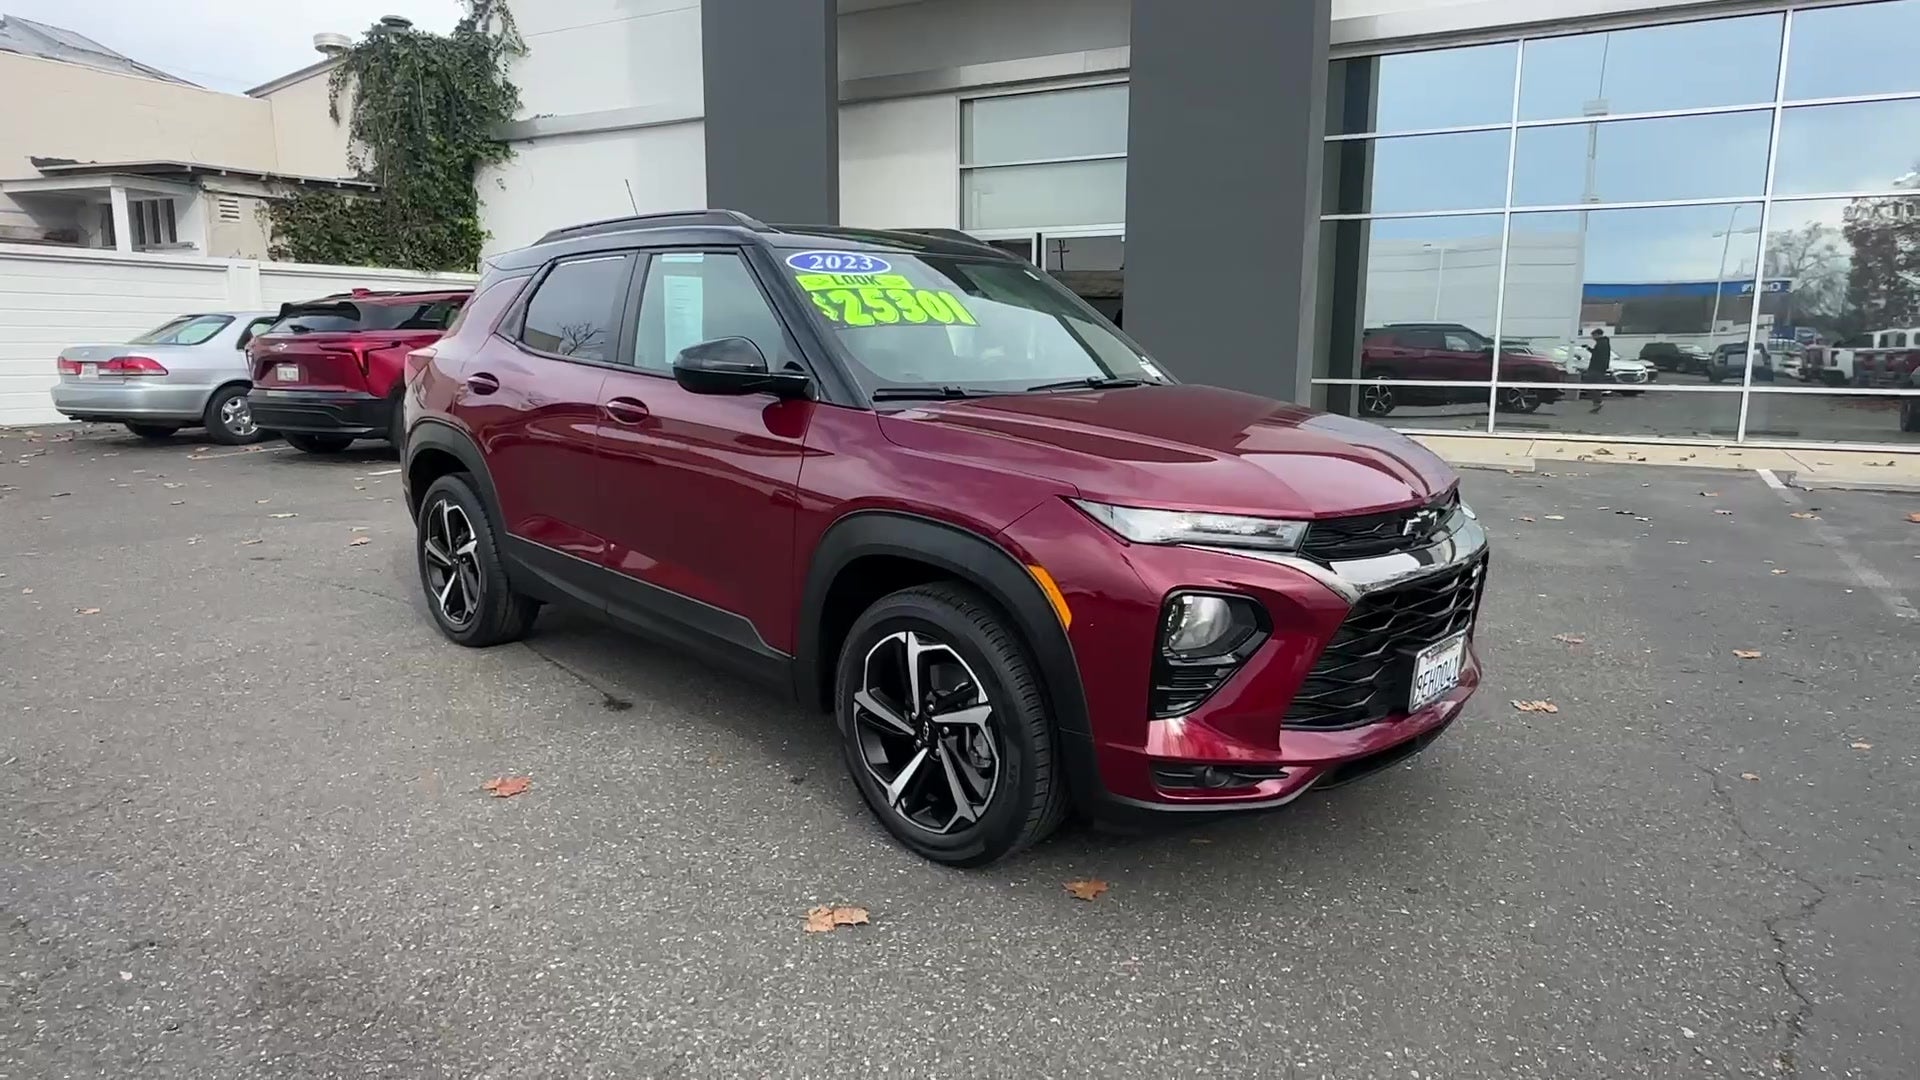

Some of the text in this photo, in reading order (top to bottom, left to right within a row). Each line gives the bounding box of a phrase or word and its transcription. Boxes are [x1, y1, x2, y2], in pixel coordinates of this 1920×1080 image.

[808, 254, 874, 271] 2023
[830, 274, 881, 287] LOOK
[811, 288, 977, 326] $25301
